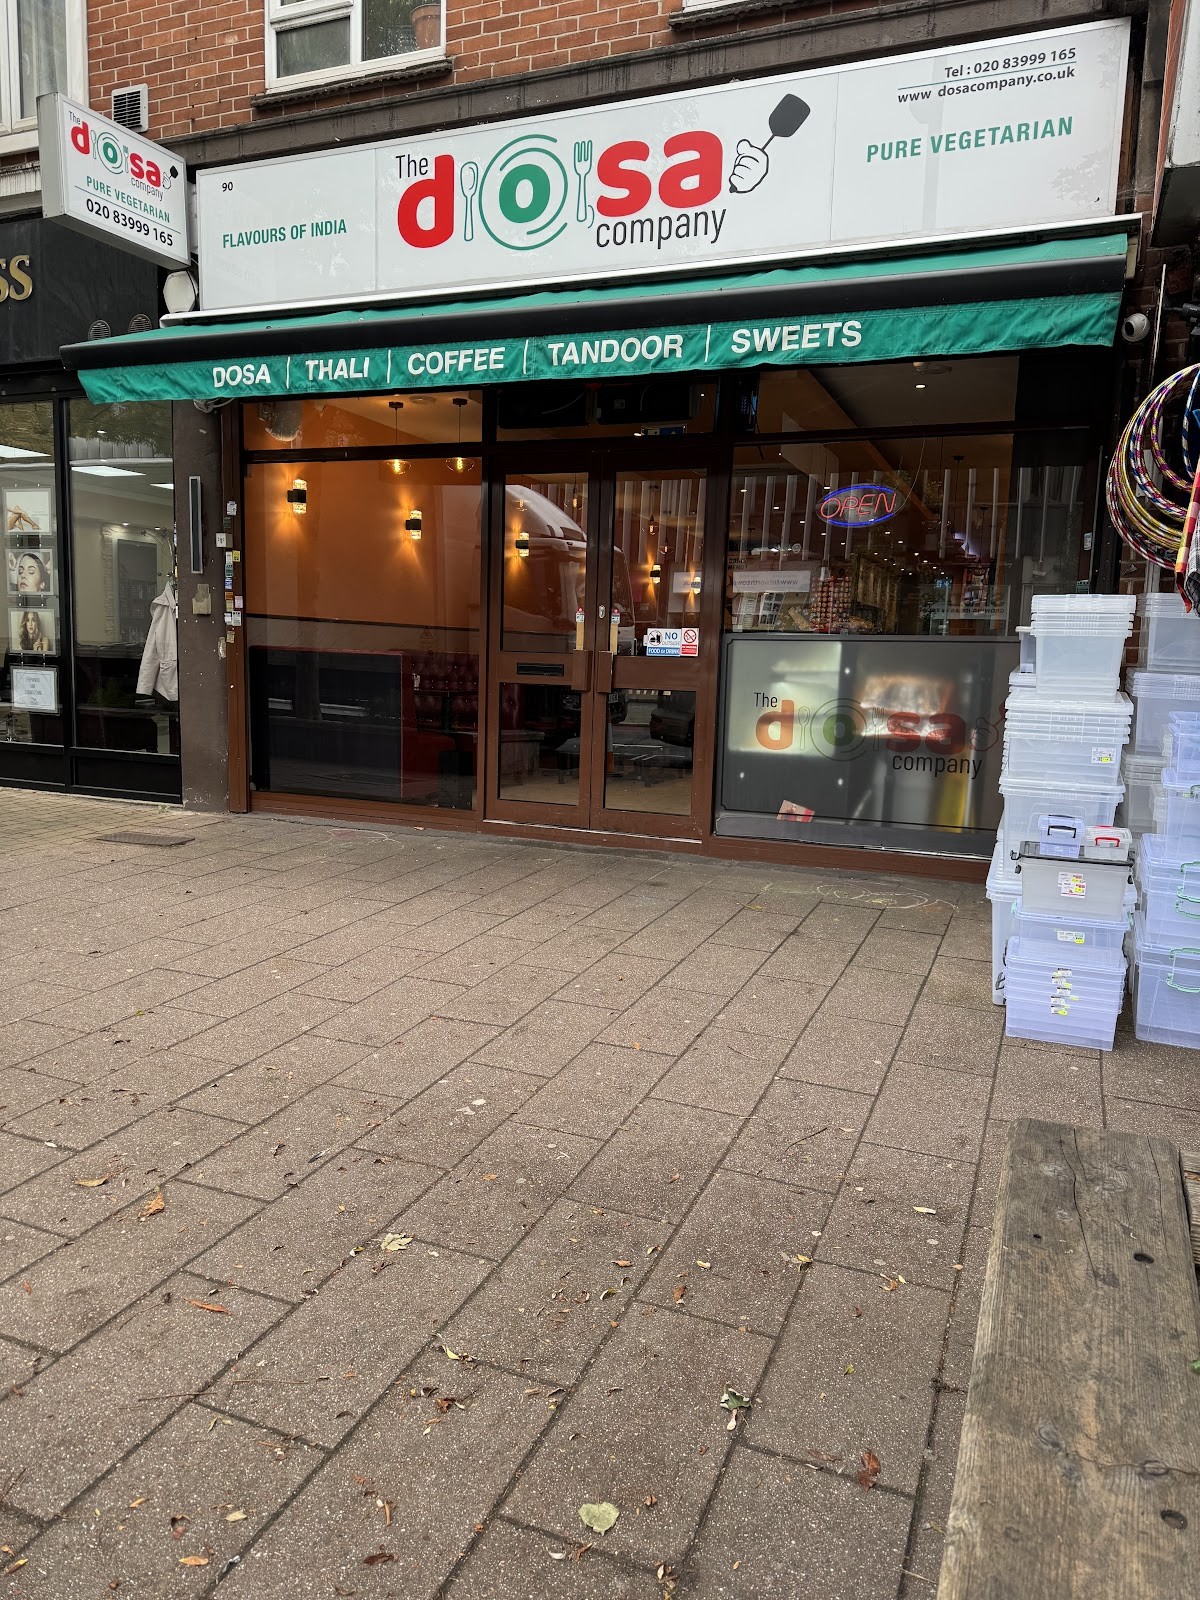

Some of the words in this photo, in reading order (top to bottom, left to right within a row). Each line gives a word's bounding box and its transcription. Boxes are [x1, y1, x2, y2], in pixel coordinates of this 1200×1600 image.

[974, 60, 999, 74] 020
[1003, 52, 1046, 69] 83999
[1051, 47, 1076, 62] 165
[898, 89, 932, 103] www
[938, 66, 1075, 97] dosacompany.co.uk
[68, 110, 81, 125] The
[866, 138, 922, 163] PURE
[930, 116, 1073, 154] VEGETARIAN
[70, 121, 162, 188] dosa
[395, 153, 429, 179] The
[86, 176, 112, 197] PURE
[114, 189, 171, 223] VEGETARIAN
[131, 177, 164, 201] company
[221, 181, 234, 192] 90
[397, 130, 724, 249] dosa
[86, 199, 110, 219] 020
[113, 211, 150, 236] 83999
[153, 227, 174, 246] 165
[222, 226, 286, 249] FLAVOURS
[290, 224, 307, 240] OF
[311, 218, 347, 238] INDIA
[596, 208, 727, 250] company
[212, 363, 271, 388] DOSA
[305, 356, 370, 380] THALI
[407, 347, 506, 375] COFFEE
[547, 334, 684, 366] TANDOOR
[731, 320, 862, 354] SWEETS
[820, 492, 897, 519] OPEN
[664, 631, 678, 640] NO
[753, 692, 778, 708] The
[892, 754, 982, 780] company
